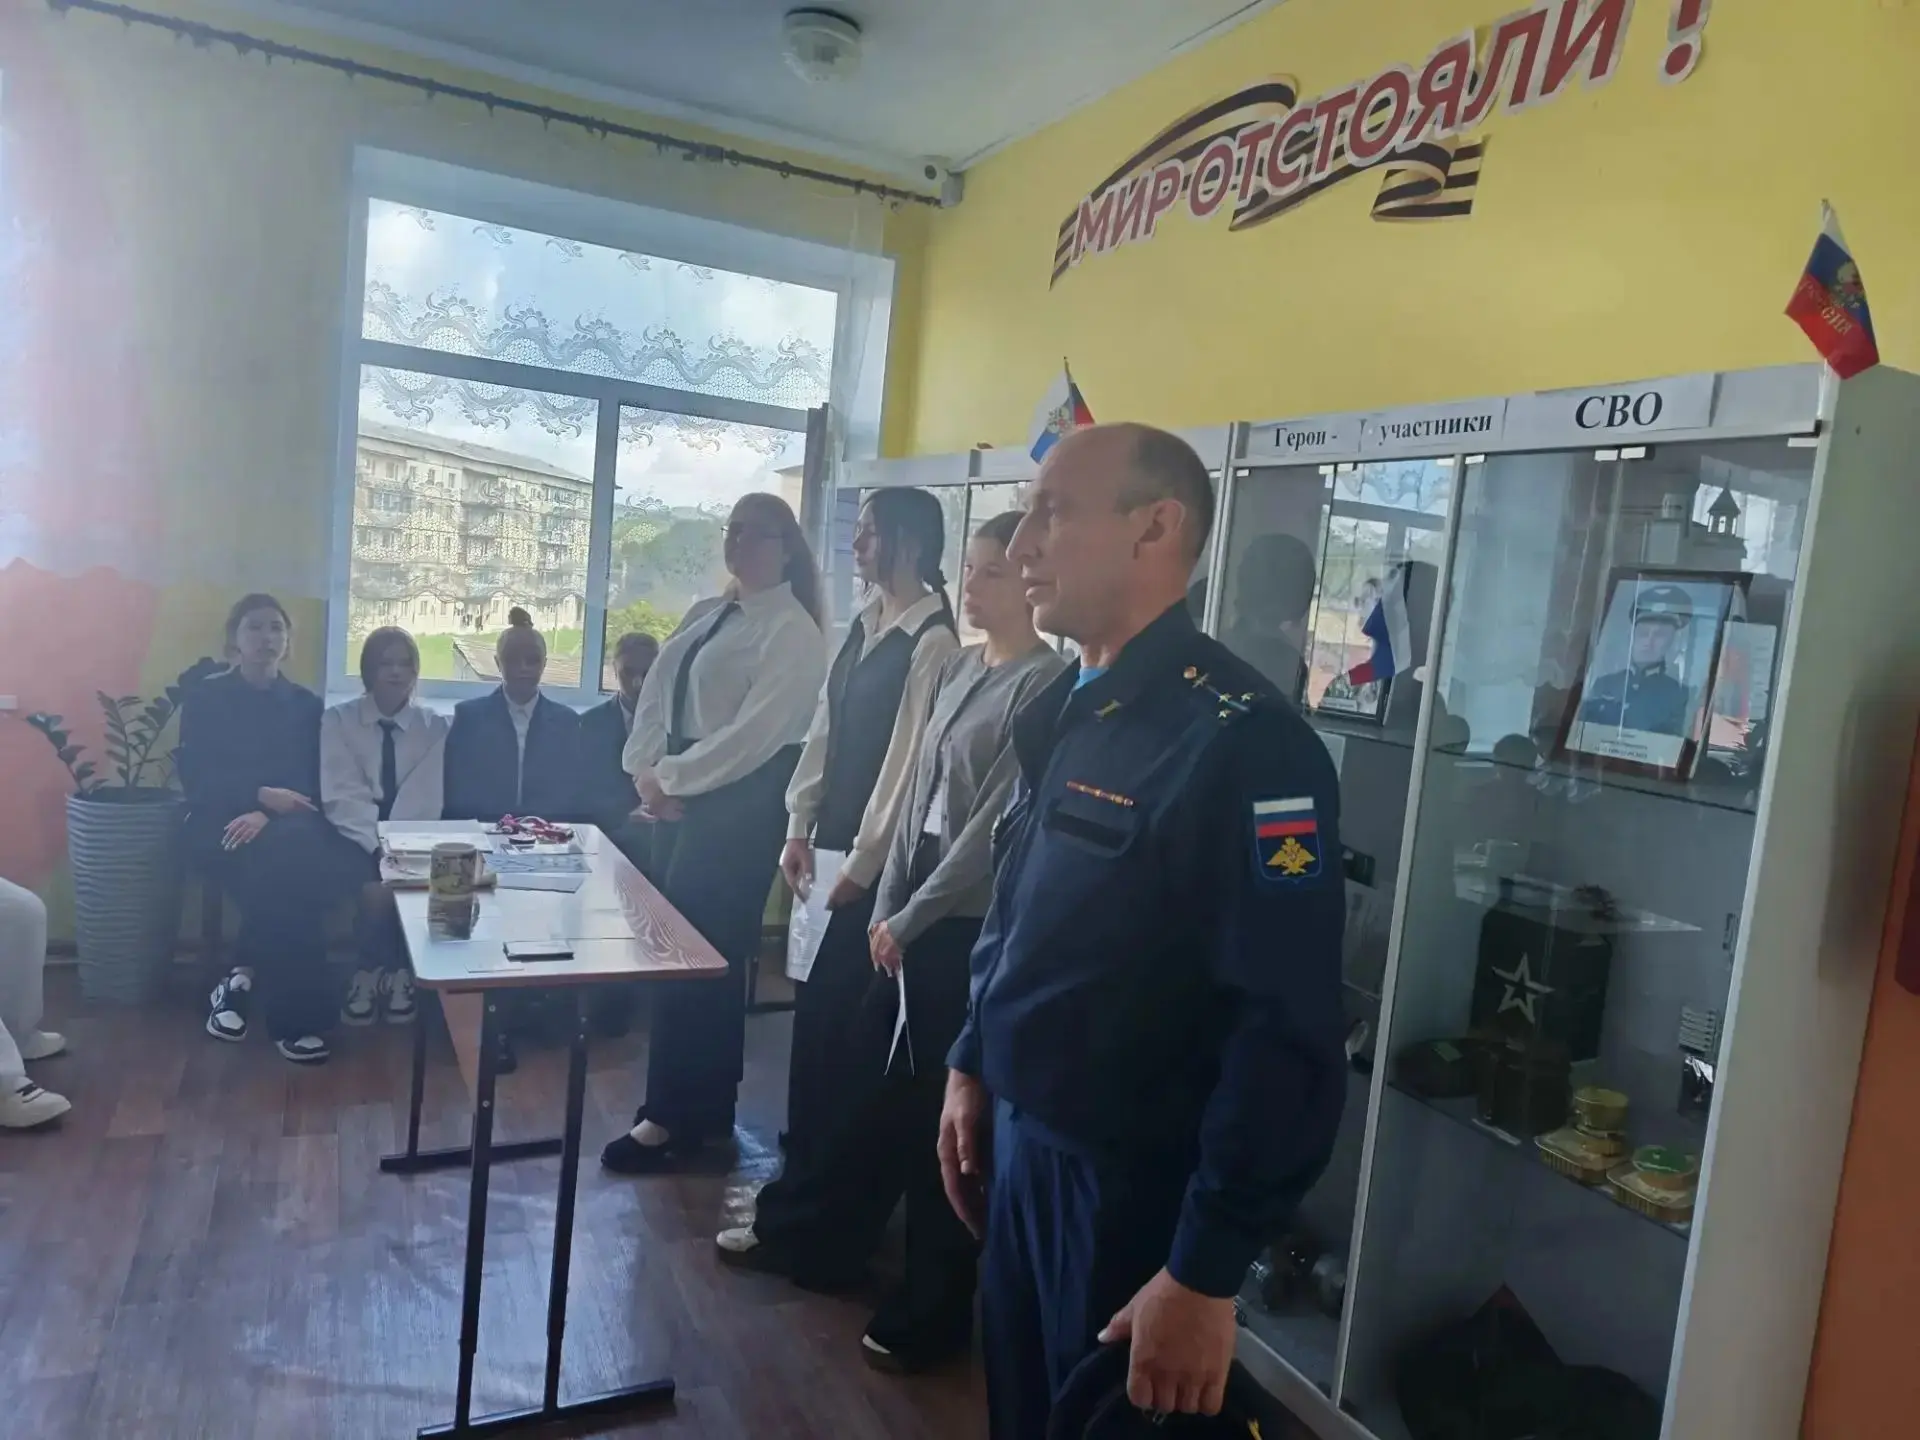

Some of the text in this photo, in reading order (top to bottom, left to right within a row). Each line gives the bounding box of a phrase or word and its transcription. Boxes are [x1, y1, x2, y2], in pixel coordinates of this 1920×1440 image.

[1071, 0, 1702, 262] МИР ОТСТОЯЛИ !
[1274, 427, 1327, 452] Герои
[1378, 415, 1493, 446] участники
[1575, 391, 1663, 429] СВО
